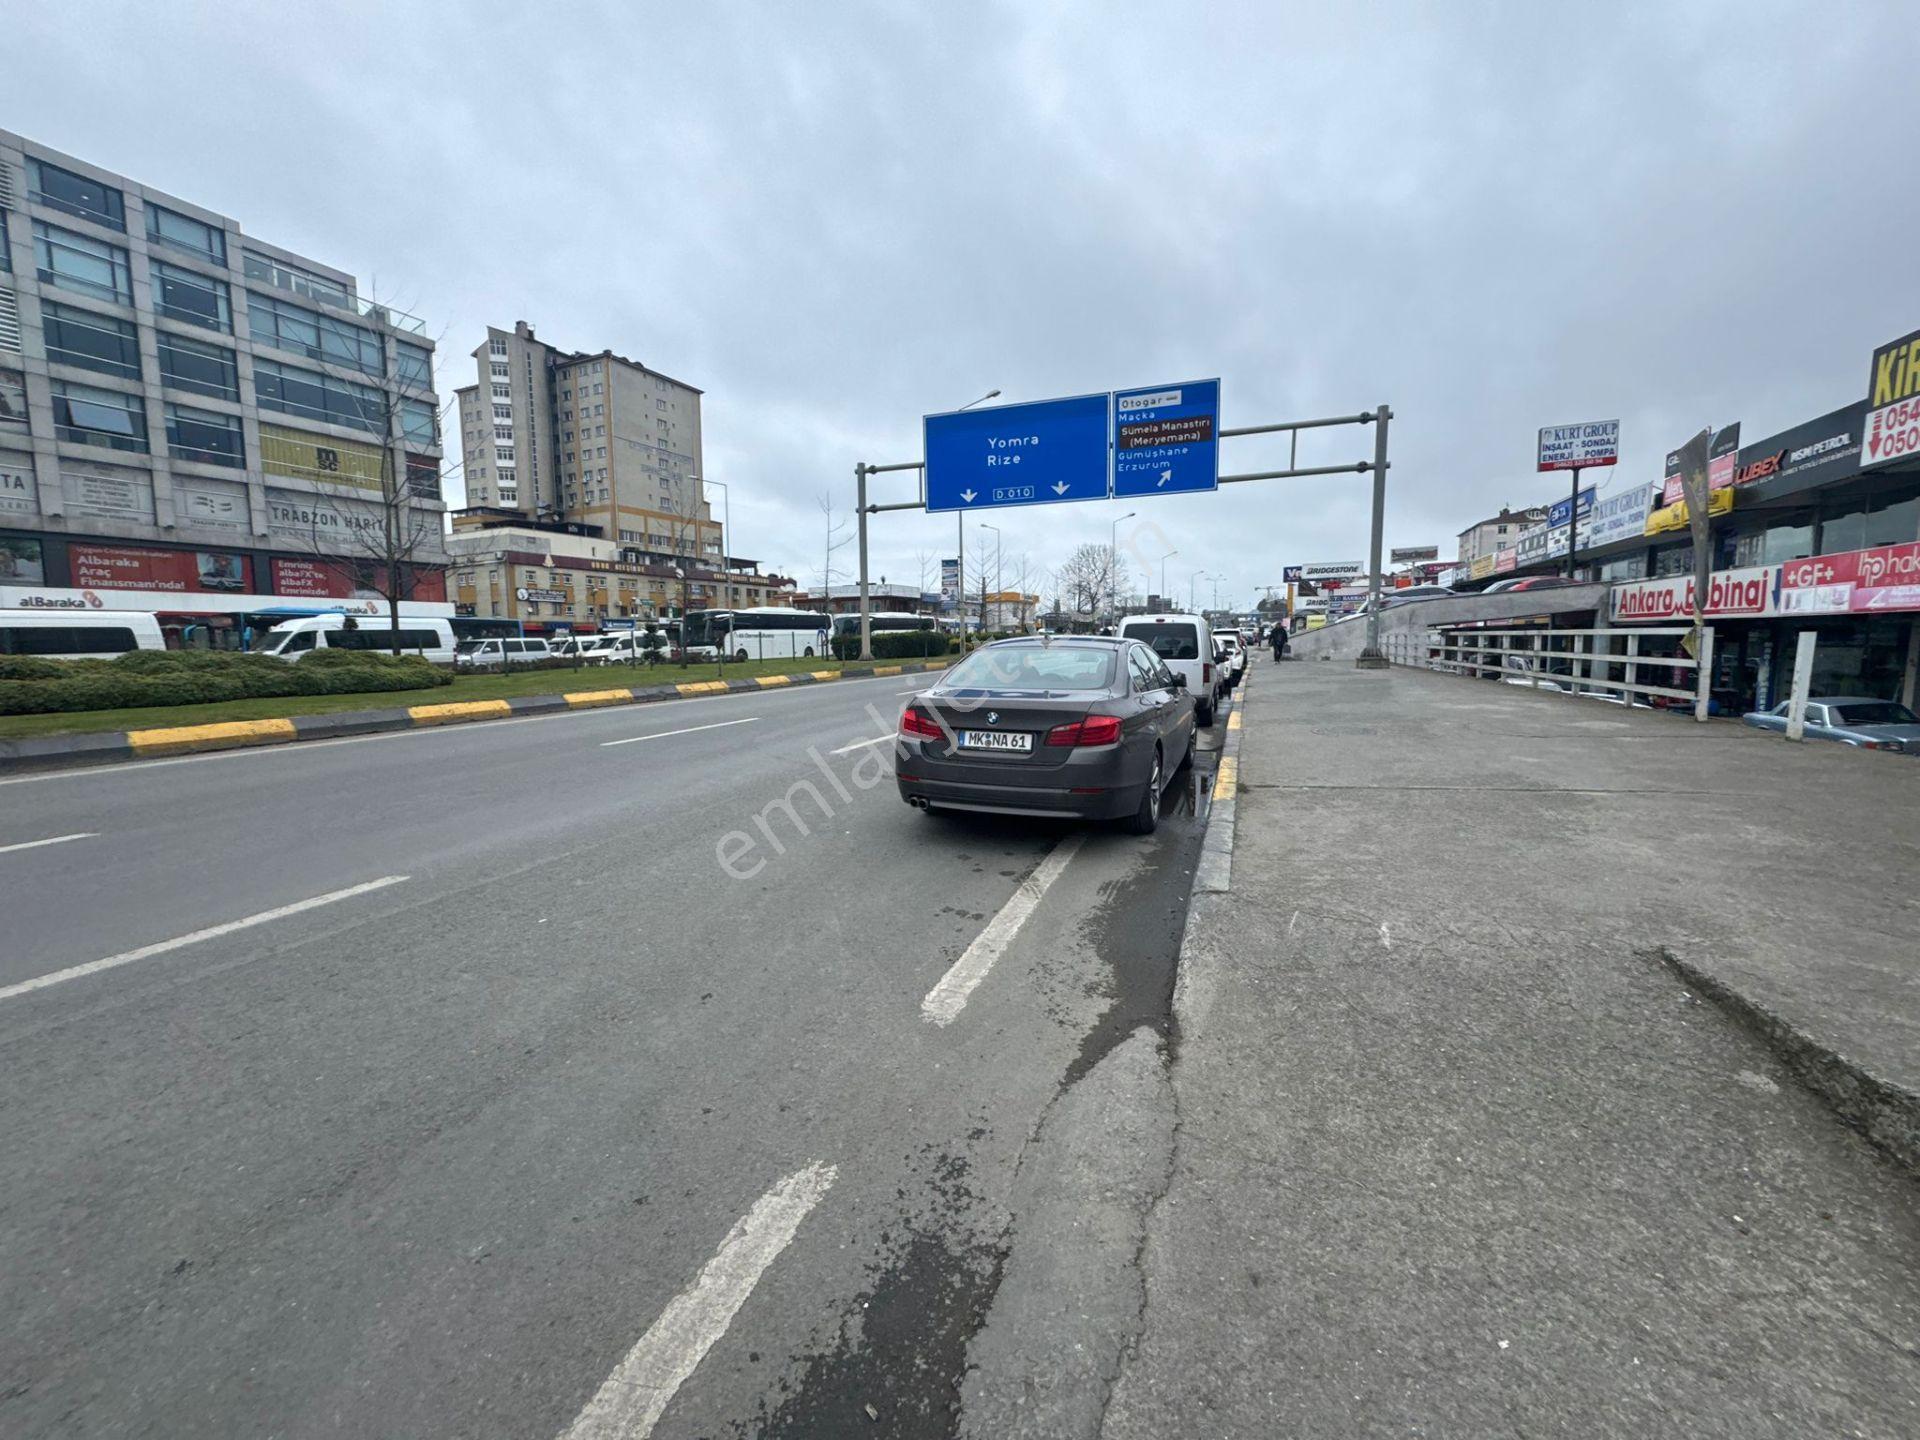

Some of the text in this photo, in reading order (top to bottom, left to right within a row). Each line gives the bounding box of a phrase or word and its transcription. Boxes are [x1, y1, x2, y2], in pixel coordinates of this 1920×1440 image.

[1121, 397, 1162, 409] Otogar
[1118, 412, 1155, 422] Maçka
[1554, 423, 1618, 441] KURT GROUP
[988, 436, 1039, 449] Yomra
[1130, 431, 1201, 448] (Meryemana)
[1581, 438, 1617, 448] SONDAJ
[1584, 447, 1615, 458] POMPA
[987, 455, 1021, 467] Rize
[1117, 461, 1170, 472] Erzurum
[1735, 449, 1788, 484] LUBEX
[272, 507, 338, 527] TRABZON
[78, 556, 140, 568] Albaraka
[278, 559, 314, 570] Emriniz
[79, 566, 112, 578] Araç
[1306, 565, 1359, 575] BRIDGESTONE
[1619, 570, 1769, 614] Ankara bbinaj
[19, 596, 86, 608] alBaraka
[969, 732, 1026, 748] MK NA 61
